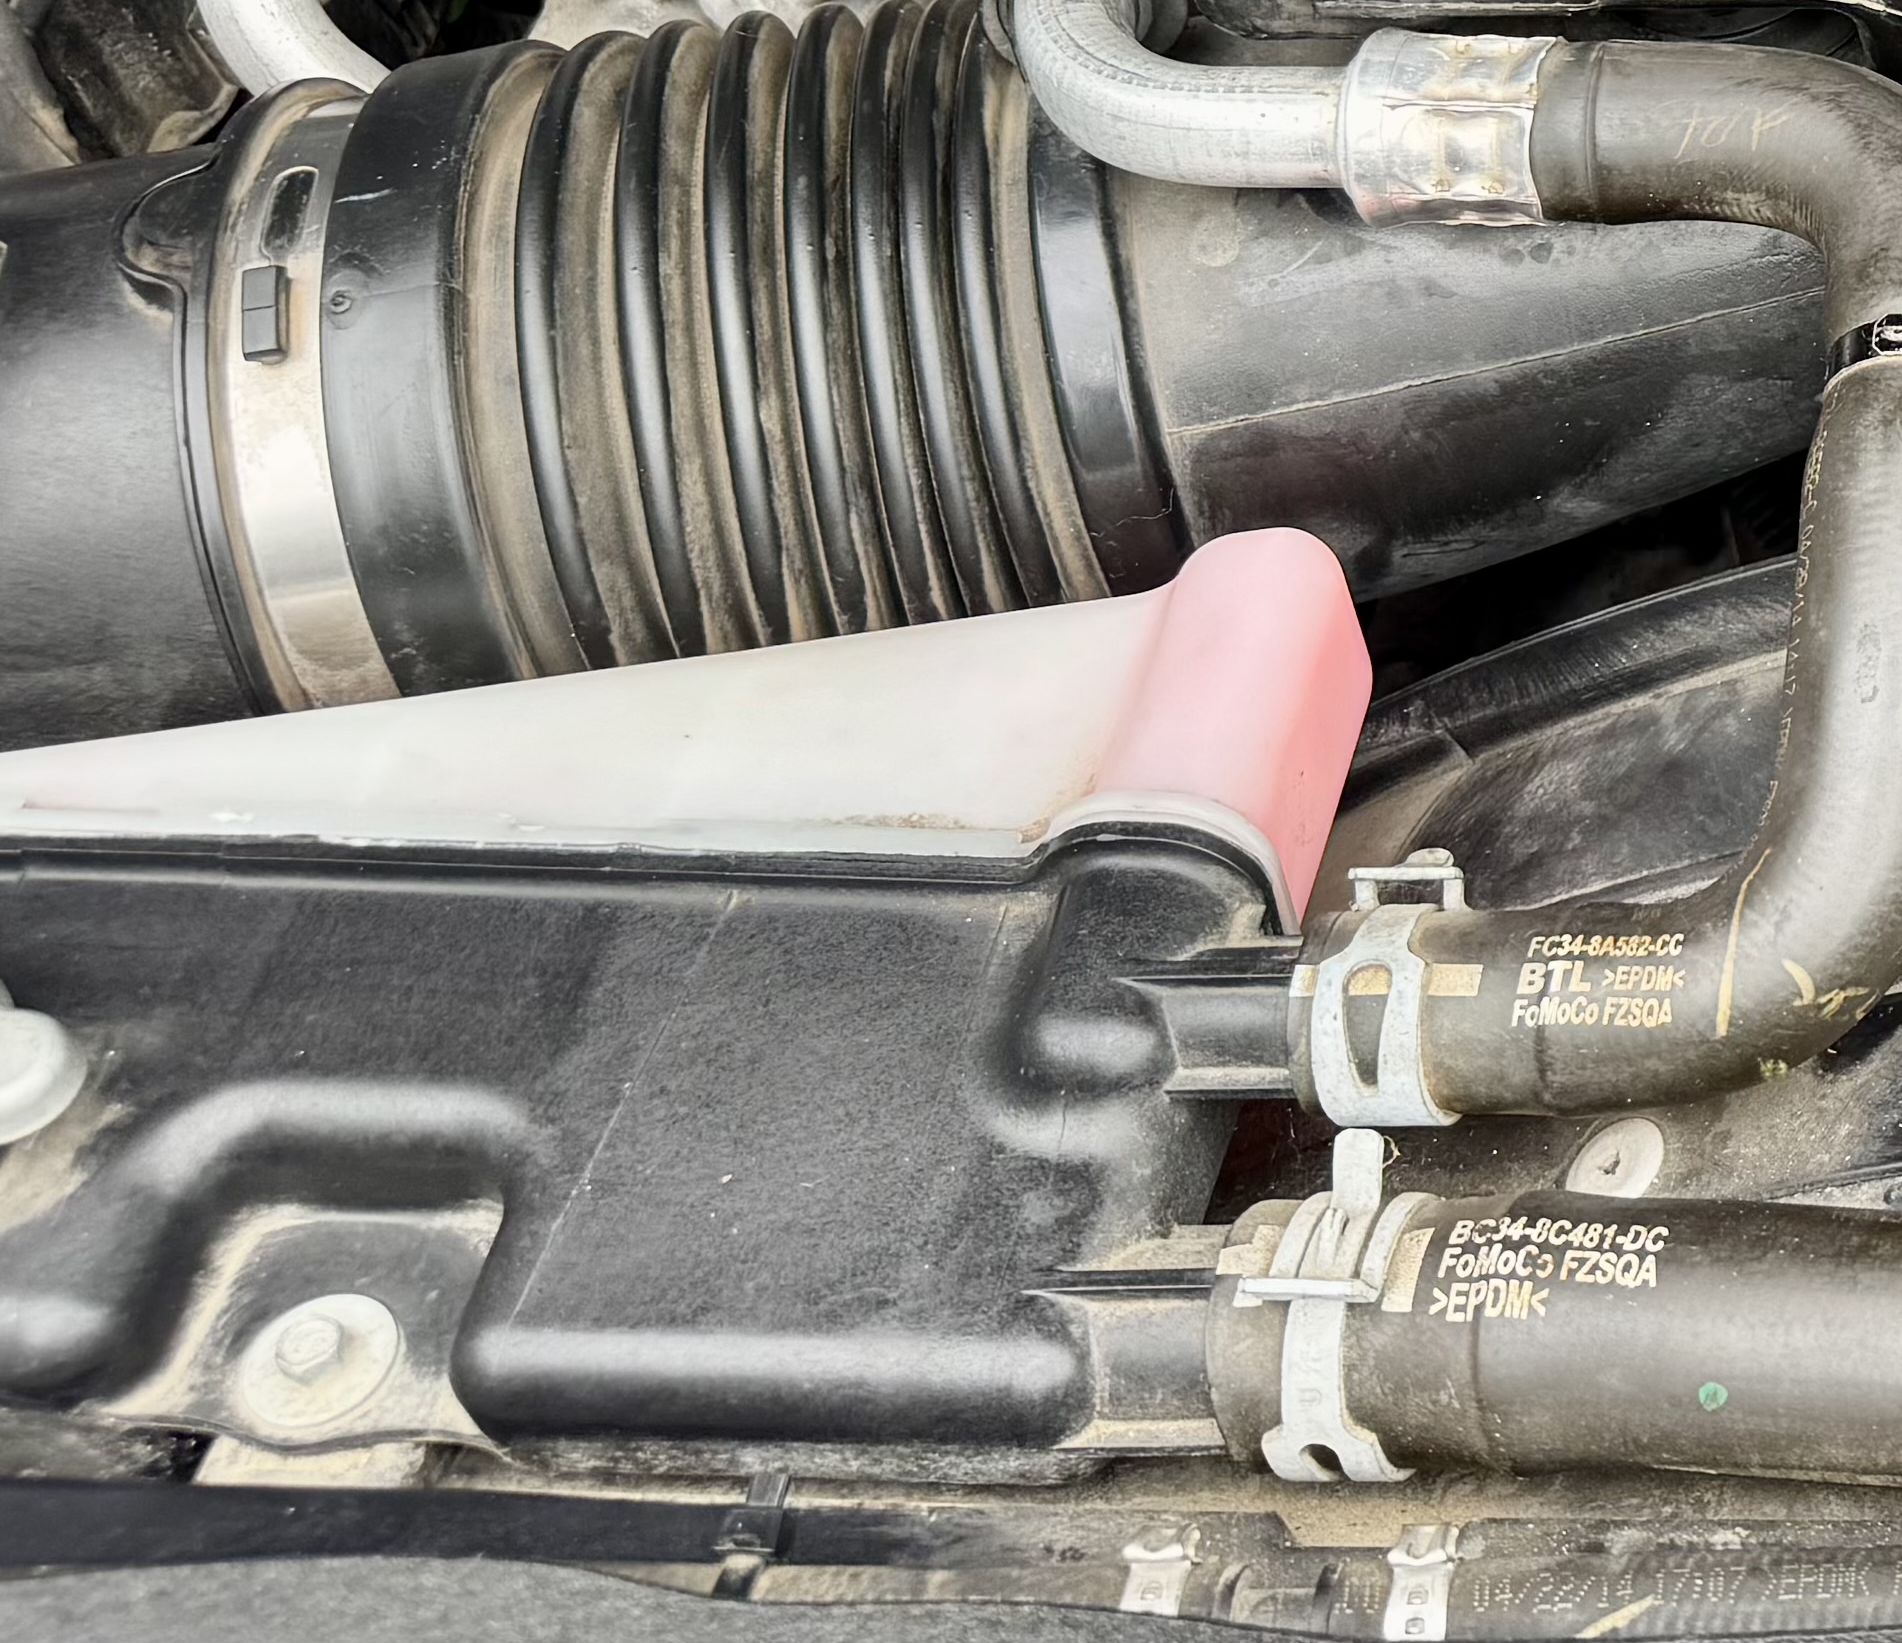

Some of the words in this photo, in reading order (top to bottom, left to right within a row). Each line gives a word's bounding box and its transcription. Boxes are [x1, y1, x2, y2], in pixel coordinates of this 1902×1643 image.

[1516, 959, 1592, 995] BTL
[1601, 965, 1687, 993] >EPDM<
[1510, 995, 1600, 1028] FoMoCo
[1602, 995, 1674, 1028] FZSQA
[1448, 1215, 1671, 1253] BC34-8C481-DC
[1436, 1242, 1555, 1279] FoMoCo
[1558, 1248, 1658, 1289] FZSQA
[1428, 1277, 1551, 1323] >EPDM<
